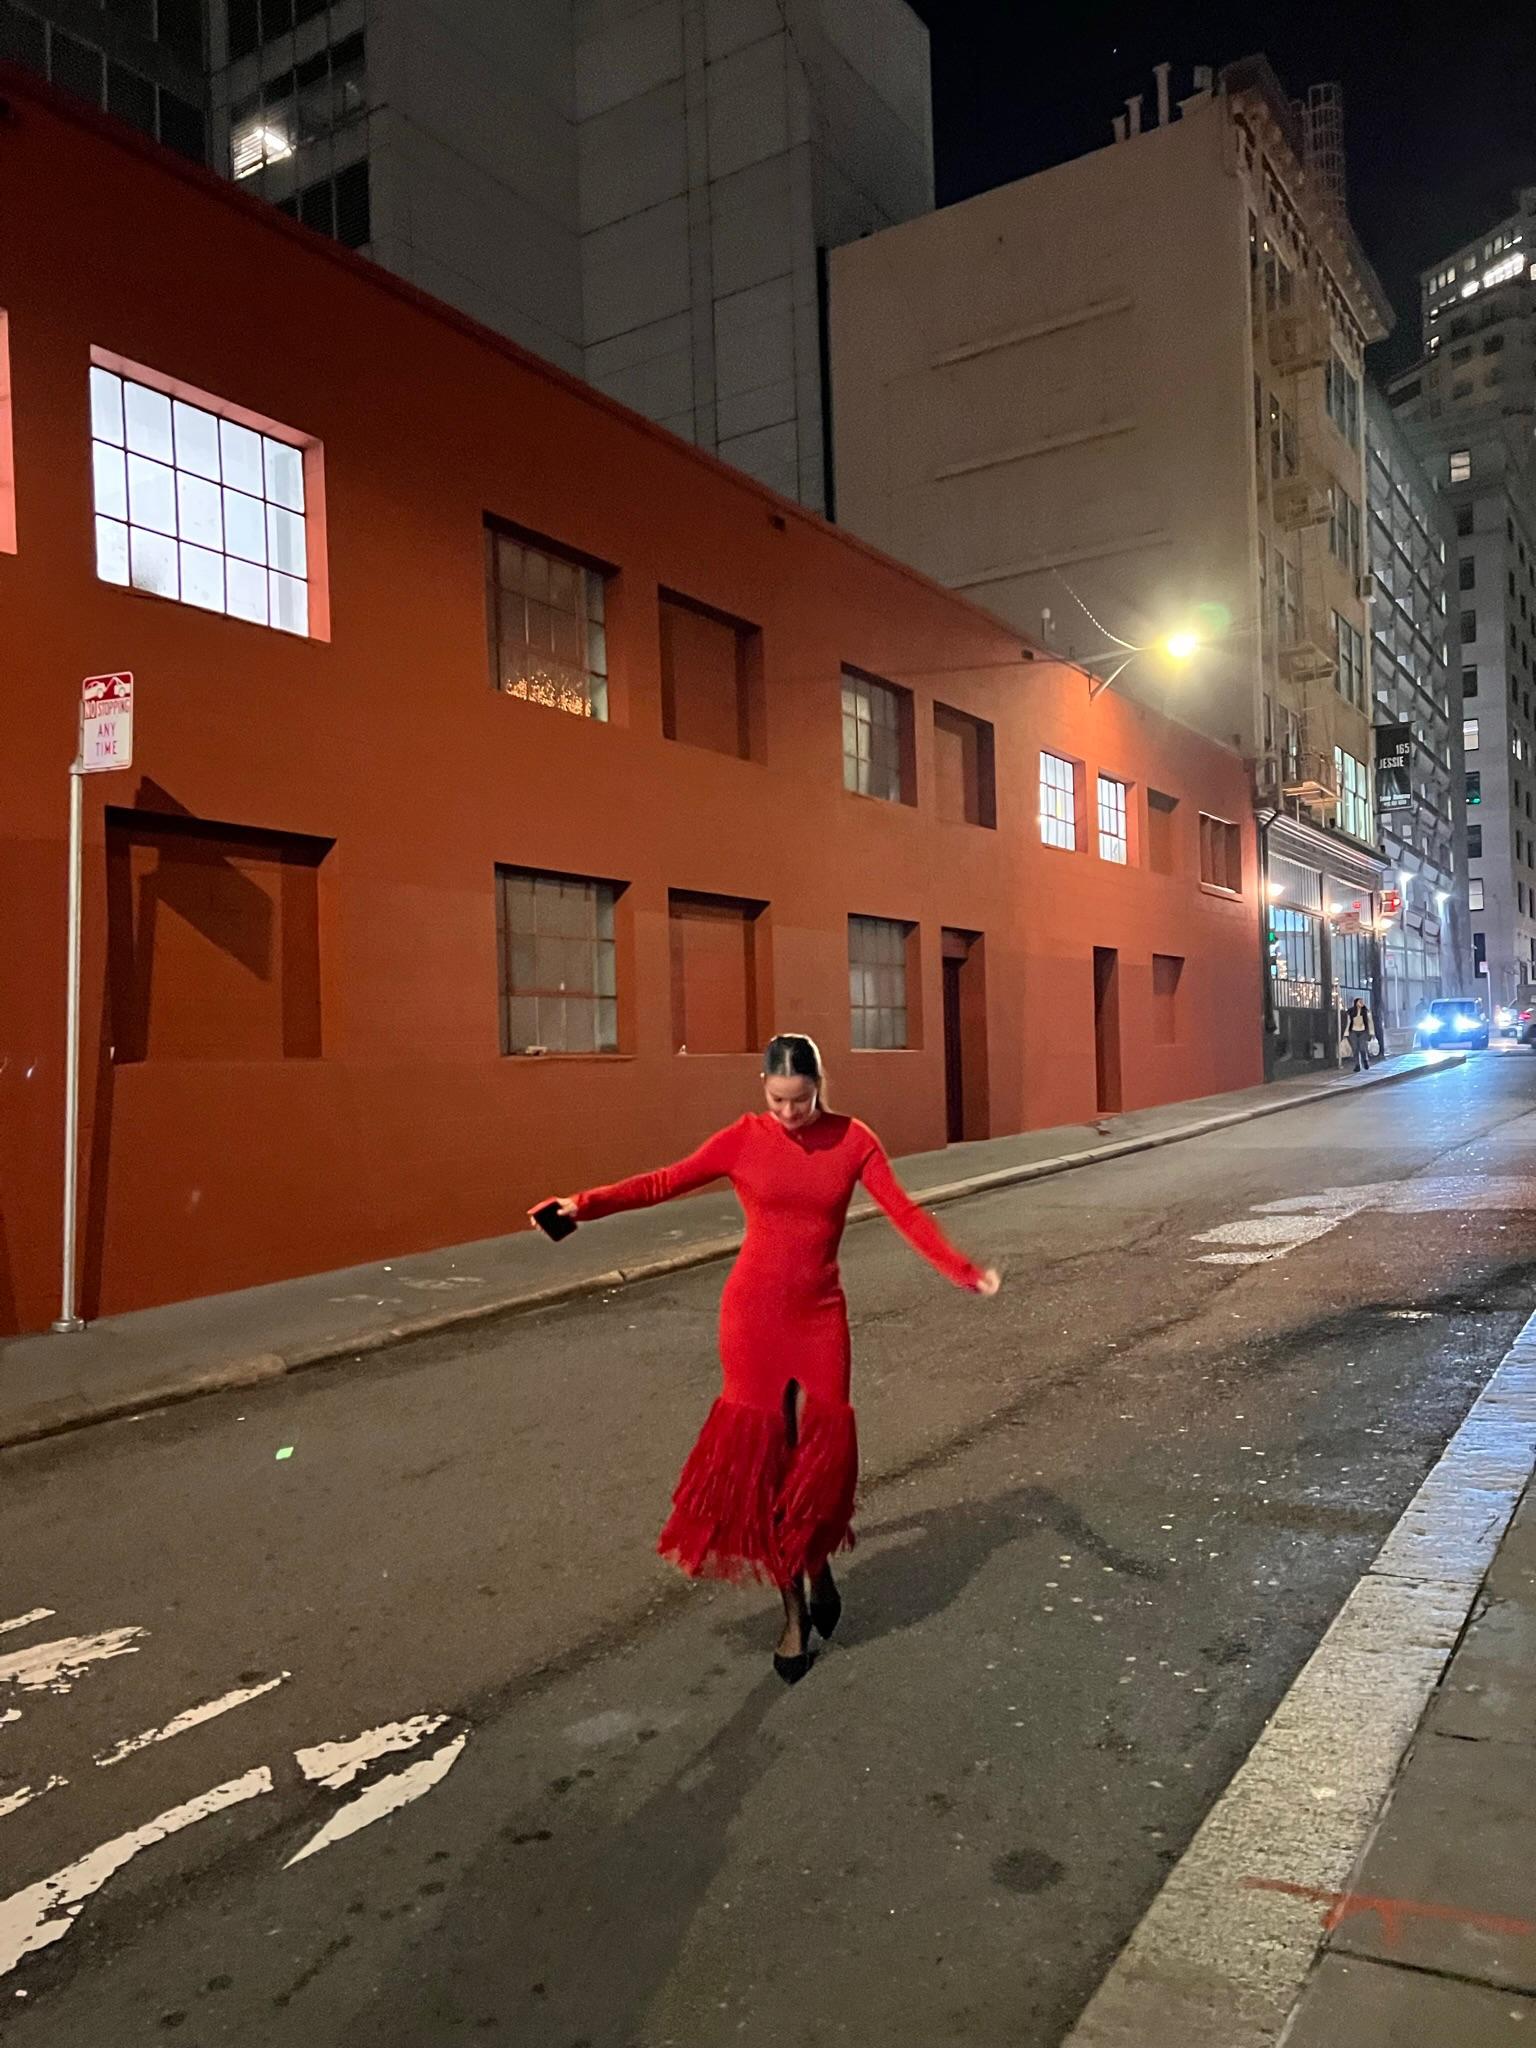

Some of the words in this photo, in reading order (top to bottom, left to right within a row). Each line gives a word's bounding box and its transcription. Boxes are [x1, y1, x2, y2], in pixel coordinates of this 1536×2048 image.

[86, 701, 96, 718] NO
[98, 722, 116, 737] ANY
[96, 741, 117, 757] TIME
[1395, 743, 1410, 755] 165
[1378, 756, 1405, 770] JESSIE
